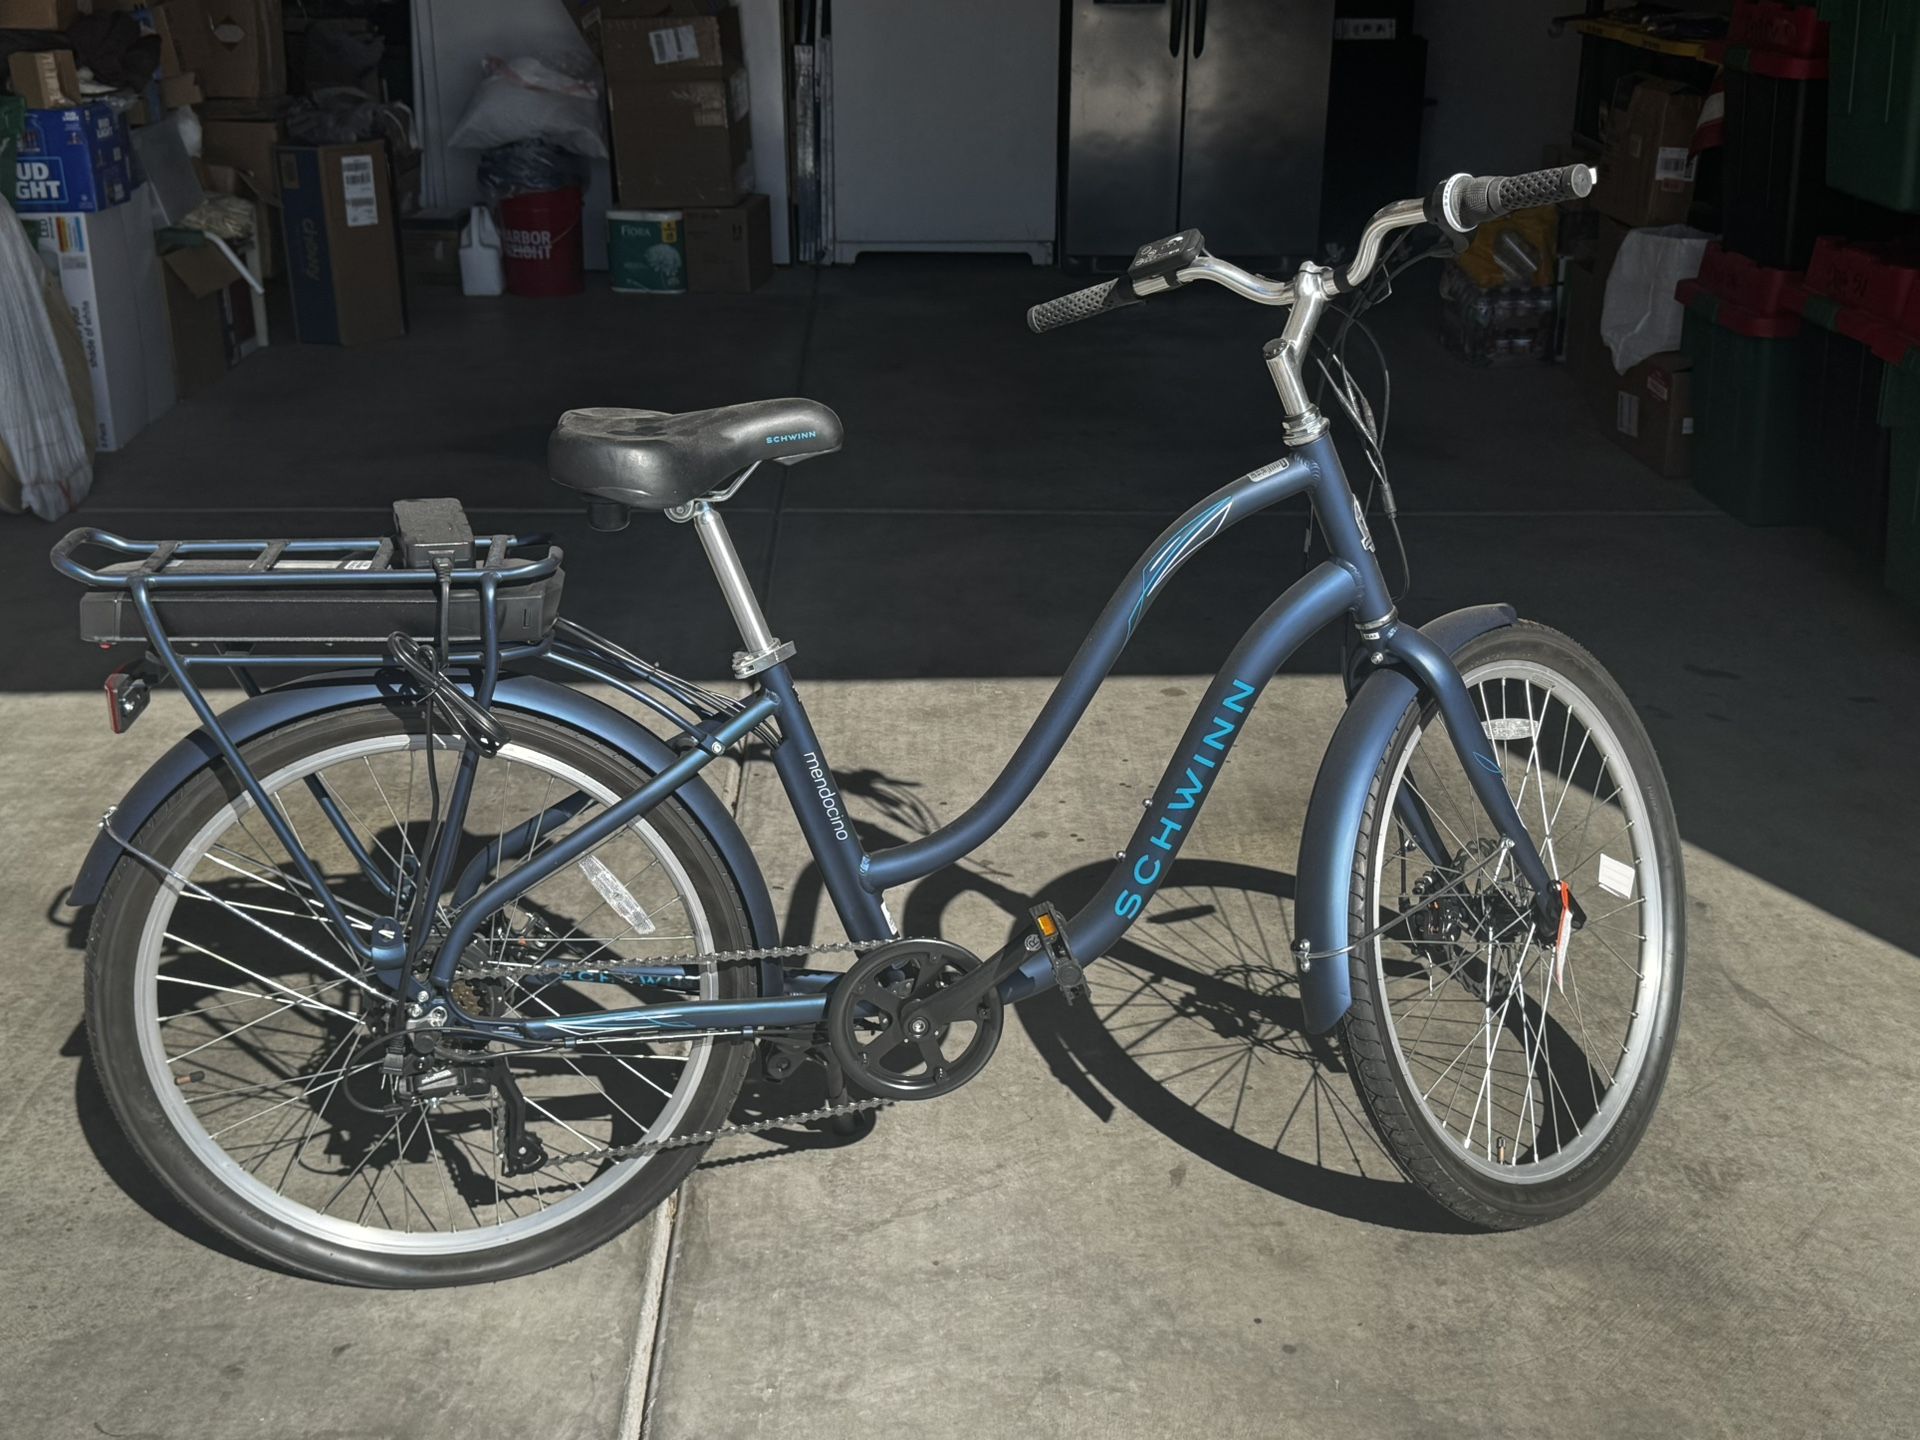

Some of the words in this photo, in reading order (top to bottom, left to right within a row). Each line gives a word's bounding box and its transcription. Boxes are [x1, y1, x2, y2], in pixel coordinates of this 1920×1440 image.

[16, 162, 50, 181] UD
[15, 181, 61, 199] GHT
[503, 229, 552, 246] ARBOR
[766, 431, 817, 444] SCHWINN
[803, 752, 848, 841] mendocino
[1114, 679, 1256, 919] SCHWINN
